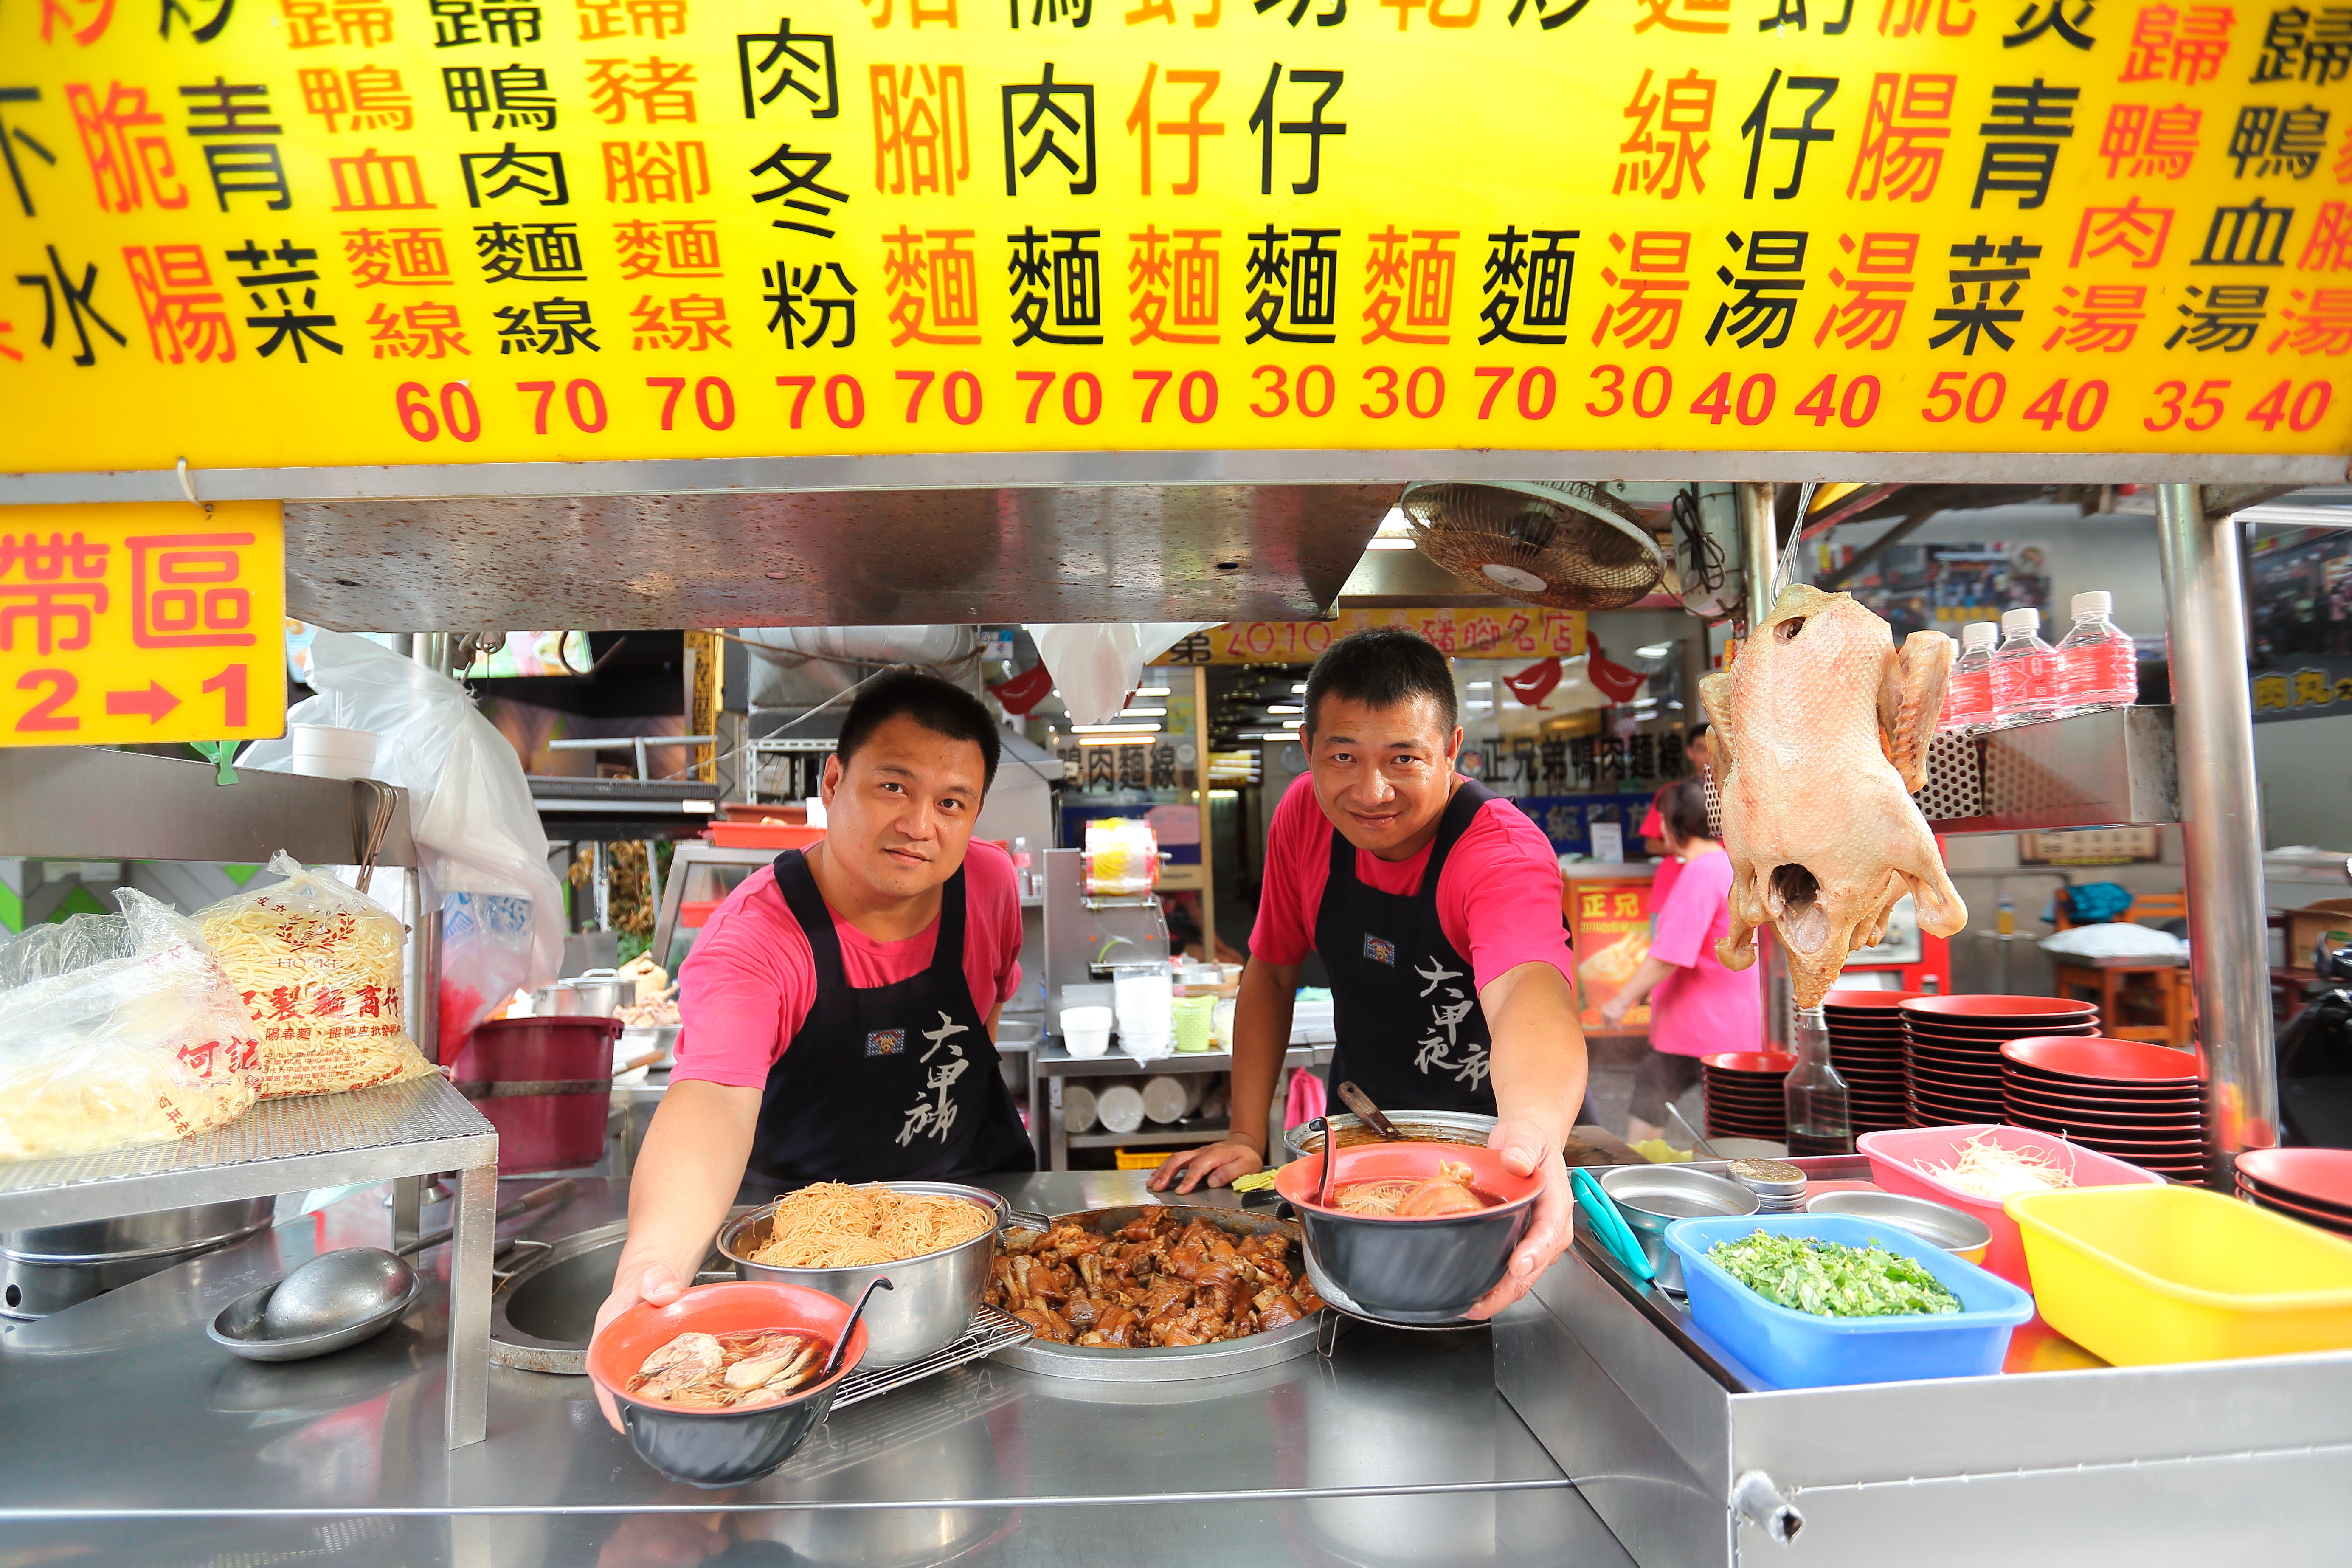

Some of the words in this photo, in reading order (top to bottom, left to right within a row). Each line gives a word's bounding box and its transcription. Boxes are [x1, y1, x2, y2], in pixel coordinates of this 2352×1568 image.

[737, 18, 858, 349] 肉冬粉
[871, 0, 981, 347] 腳麵
[1002, 0, 1103, 347] 肉麵
[1127, 0, 1224, 346] 仔麵
[1245, 0, 1346, 344] 仔麵
[1361, 0, 1479, 345] 麵
[1478, 0, 1589, 345] 麵
[1591, 0, 1729, 349] 線湯
[2041, 2, 2238, 354] 歸鴨肉湯
[396, 381, 481, 442] 60
[516, 378, 608, 434] 70
[646, 376, 735, 431] 70
[776, 374, 864, 429] 70
[895, 370, 982, 425] 70
[1016, 370, 1102, 425] 70
[1133, 370, 1218, 423] 70
[1250, 364, 1335, 418] 30
[1360, 366, 1445, 419] 30
[1474, 366, 1556, 420] 70
[1585, 364, 1672, 418] 30
[1690, 372, 1776, 426] 40
[1794, 374, 1881, 428] 40
[1922, 371, 2006, 424] 50
[2022, 377, 2110, 432] 40
[2143, 377, 2233, 433] 35
[2245, 376, 2334, 434] 40
[15, 668, 80, 732] 2
[202, 664, 248, 727] 1
[1414, 955, 1490, 1092] 大甲夜市
[1582, 893, 1640, 918] 正兄
